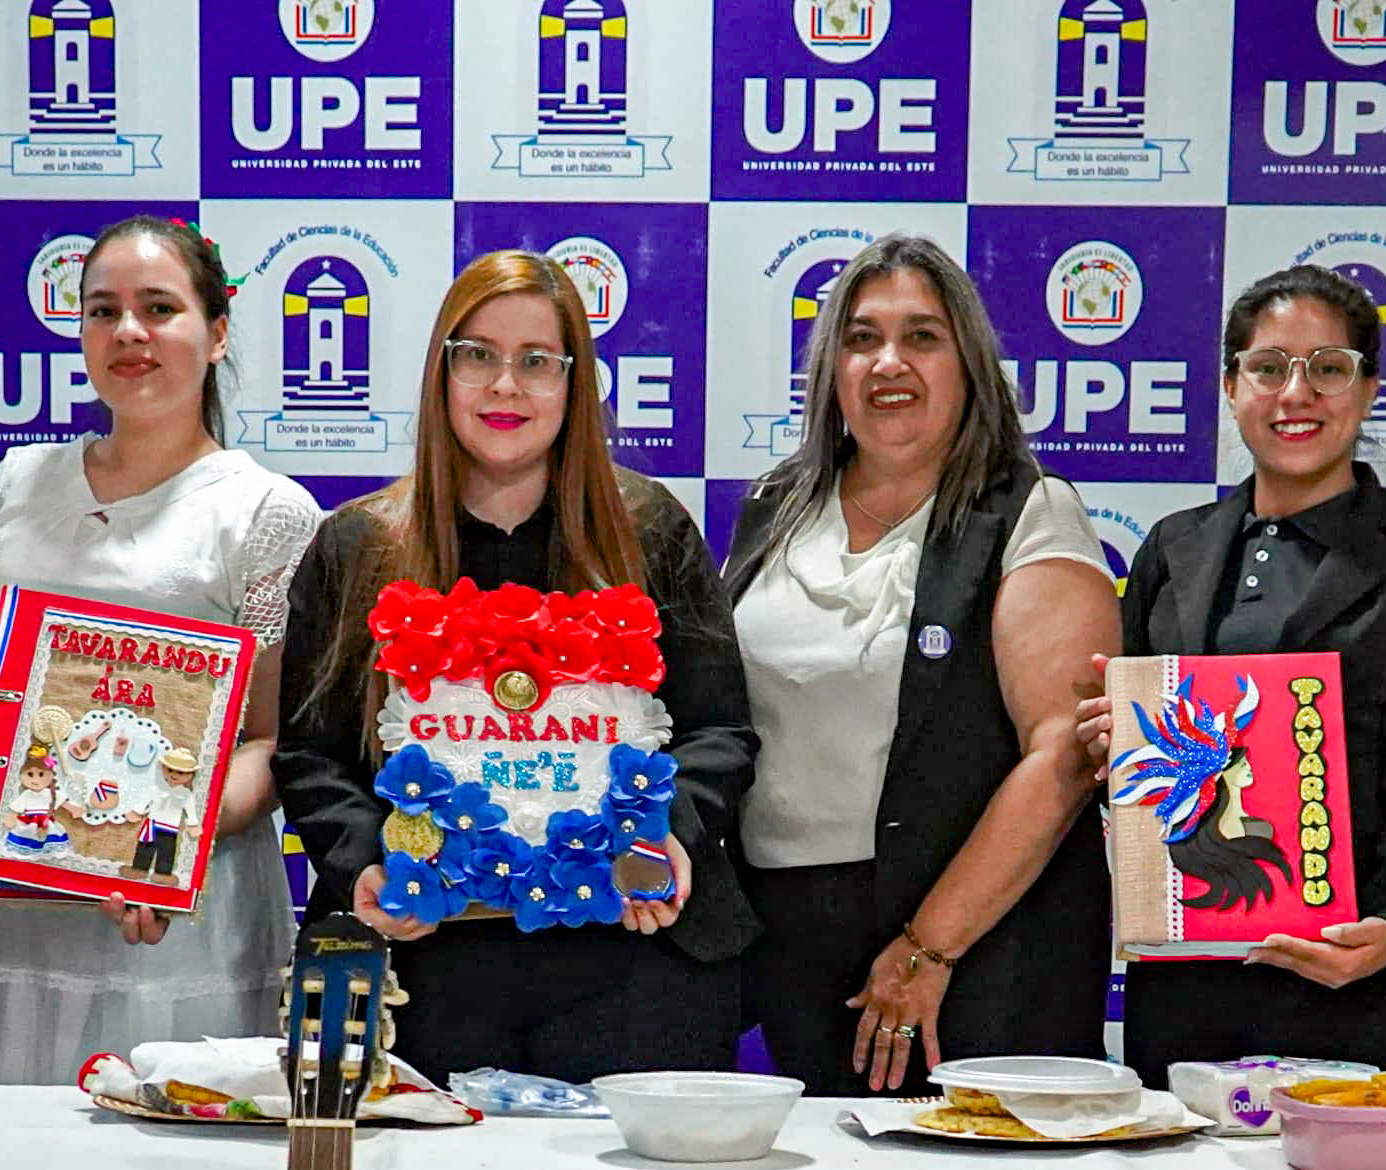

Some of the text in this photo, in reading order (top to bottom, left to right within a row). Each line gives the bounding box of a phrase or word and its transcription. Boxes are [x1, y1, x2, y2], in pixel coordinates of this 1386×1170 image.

[230, 77, 422, 152] UPE
[743, 79, 938, 153] UPE
[232, 159, 421, 169] UNIVERSIDAD PRIVADA DEL ESTE
[742, 161, 935, 172] UNIVERSIDAD PRIVADA DEL ESTE
[1261, 165, 1340, 174] UNIVERSIDAD
[48, 624, 232, 678] TAVARANDU
[409, 713, 620, 744] GUARANI
[1289, 677, 1332, 906] TAVARANDU
